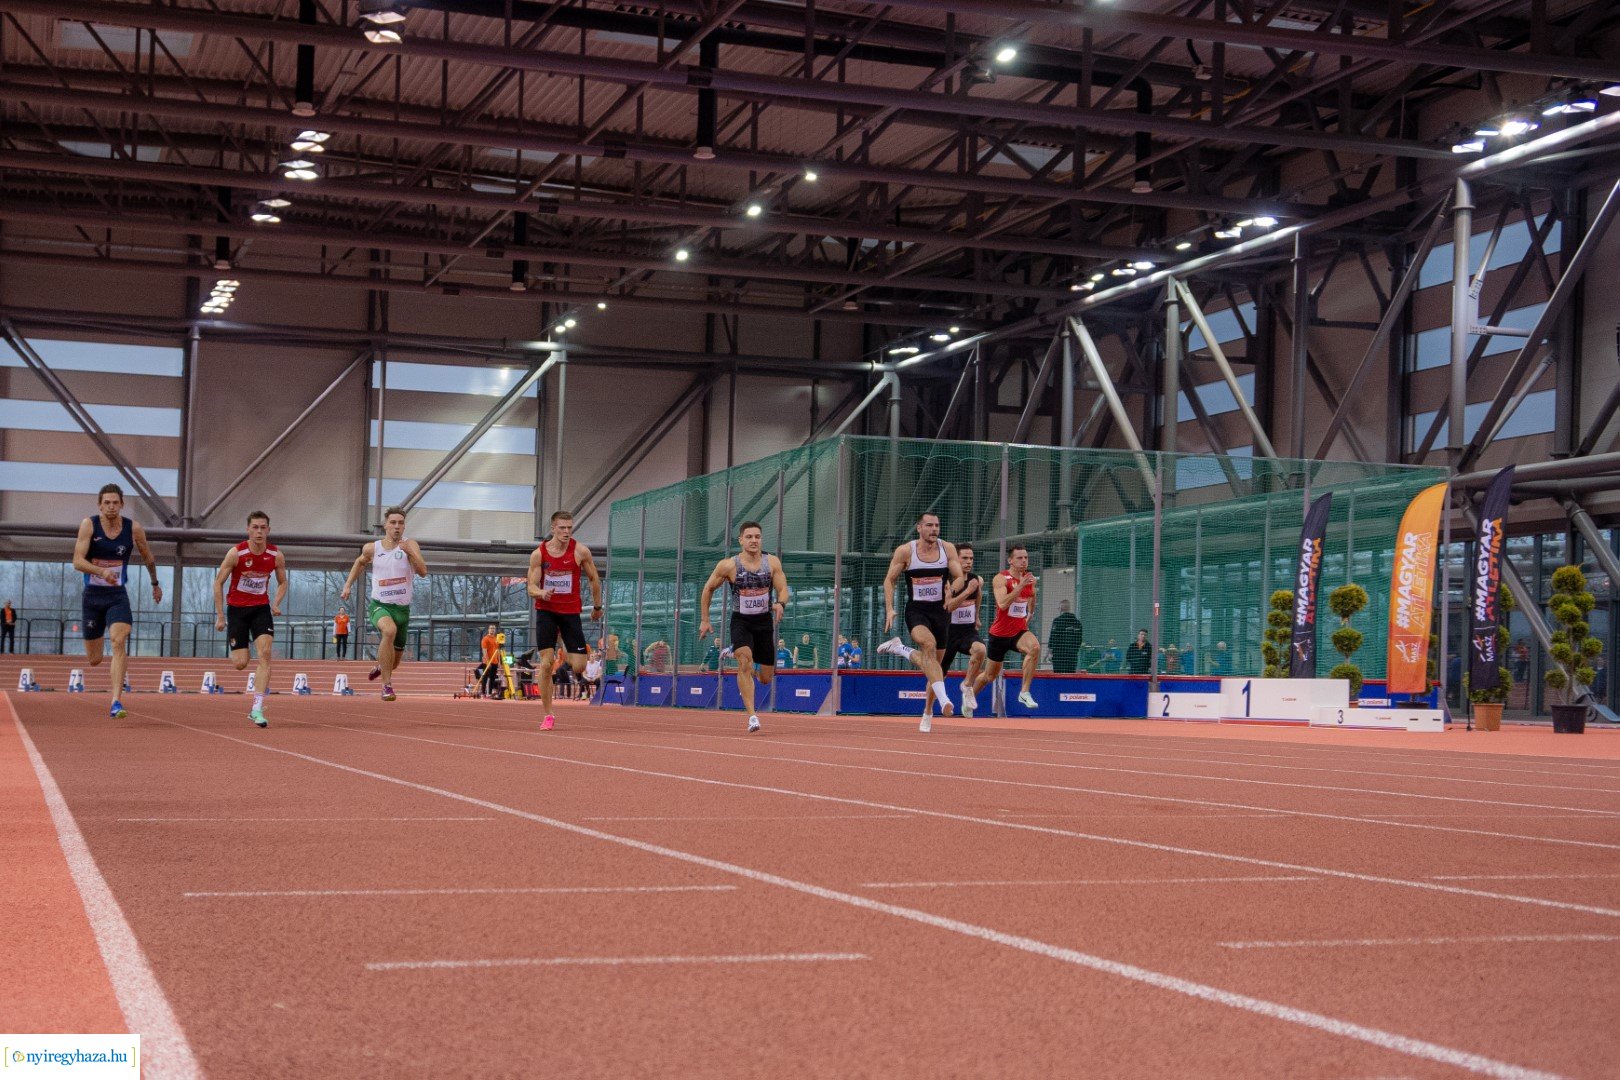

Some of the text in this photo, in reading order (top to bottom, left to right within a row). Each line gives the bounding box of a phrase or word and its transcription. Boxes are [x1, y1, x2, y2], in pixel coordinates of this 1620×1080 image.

[1296, 538, 1313, 626] #MAGYAR
[1396, 532, 1419, 629] #MAGYAR
[1409, 531, 1432, 629] ATLETIKA
[1475, 518, 1493, 621] #MAGYAR
[918, 588, 938, 597] BOROS
[1486, 635, 1494, 662] MASZ
[1162, 694, 1170, 717] 2
[1242, 680, 1251, 717] 1
[1337, 709, 1344, 724] 3
